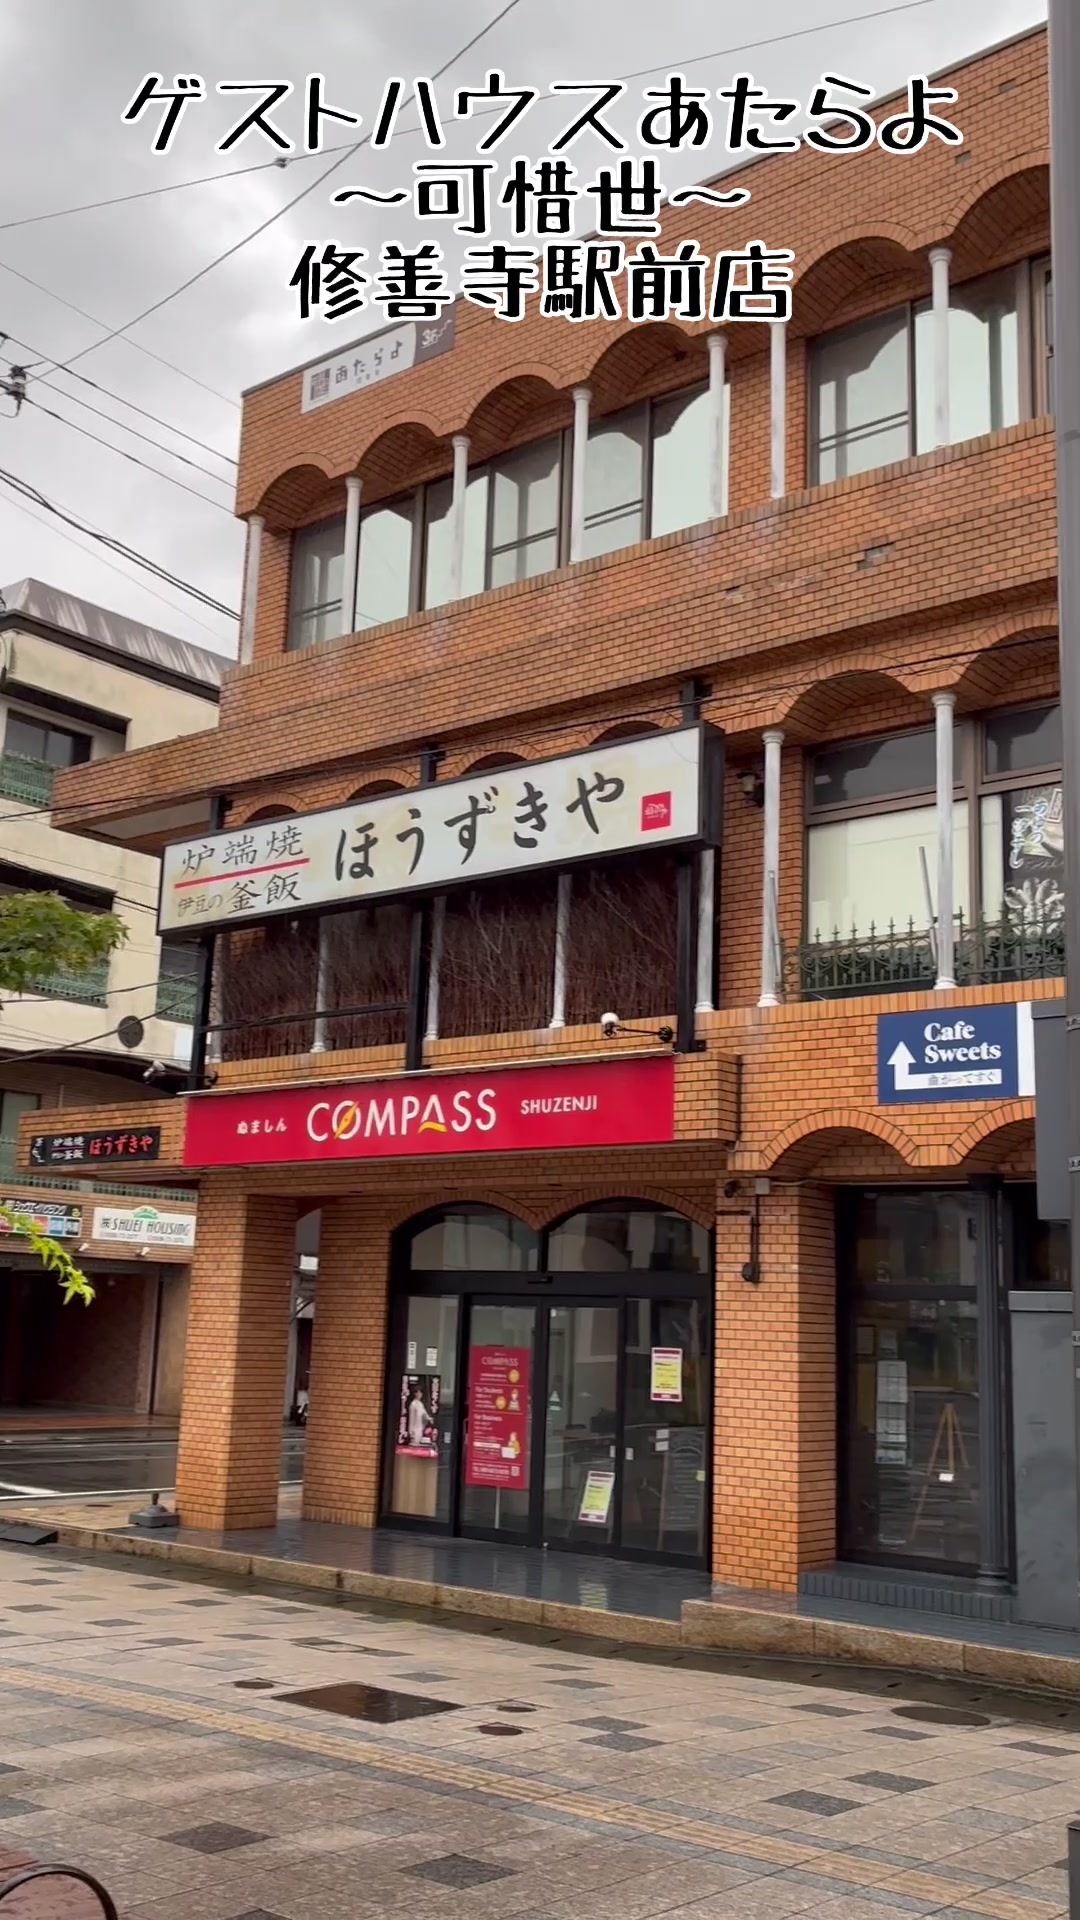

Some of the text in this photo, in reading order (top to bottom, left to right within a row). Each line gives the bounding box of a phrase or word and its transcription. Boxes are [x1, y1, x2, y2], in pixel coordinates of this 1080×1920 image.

[335, 340, 403, 384] あたらよ
[335, 772, 625, 881] ほうずきや
[182, 825, 304, 876] 炉端焼
[177, 872, 303, 918] 伊豆の釜飯
[924, 1020, 975, 1042] Cafe
[924, 1042, 1002, 1063] Sweets
[306, 1088, 497, 1142] COMPASS
[520, 1095, 598, 1115] SHUZENJI
[236, 1117, 288, 1135] ぬましん
[89, 1135, 154, 1156] ほうずきや
[111, 1217, 143, 1232] SHUEI
[146, 1220, 191, 1237] HOUSING
